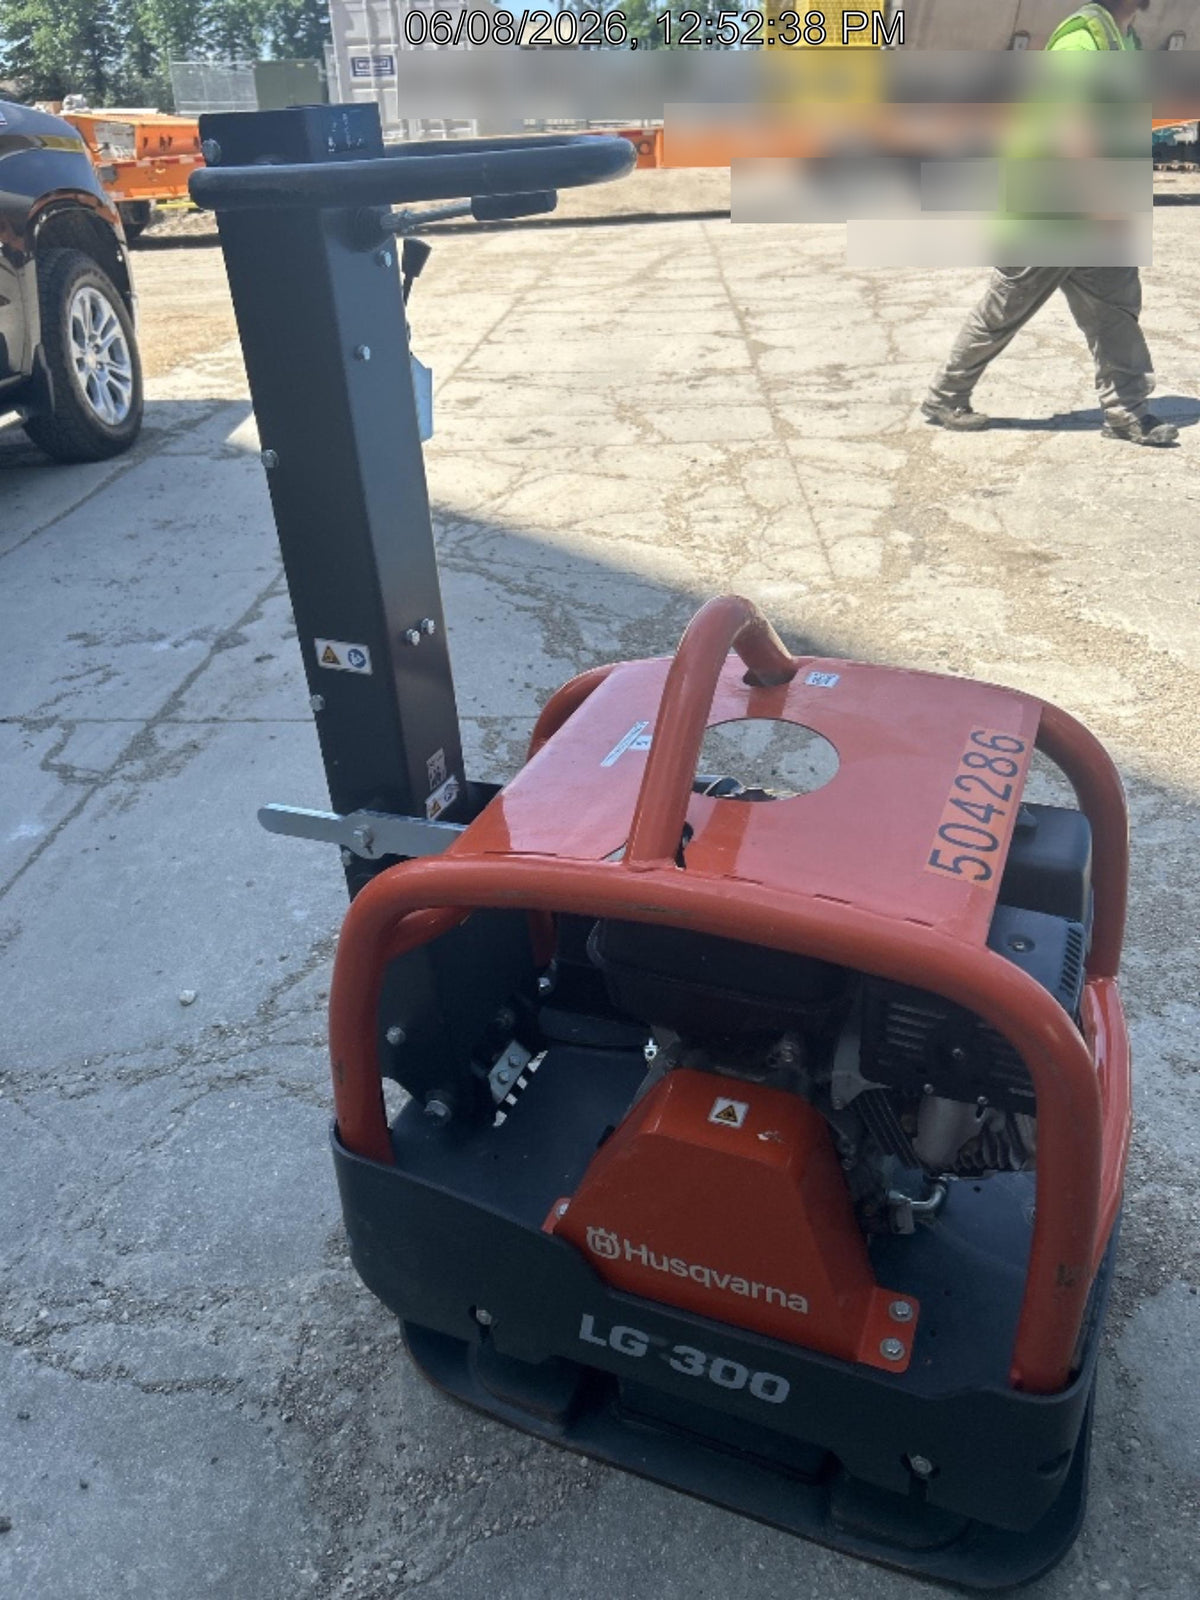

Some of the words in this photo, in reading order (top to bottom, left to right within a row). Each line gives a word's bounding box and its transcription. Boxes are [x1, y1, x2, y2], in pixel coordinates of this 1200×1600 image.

[928, 730, 1025, 881] 504286
[624, 1238, 809, 1315] Husqvarna
[579, 1313, 651, 1358] LG
[669, 1344, 791, 1404] 300
